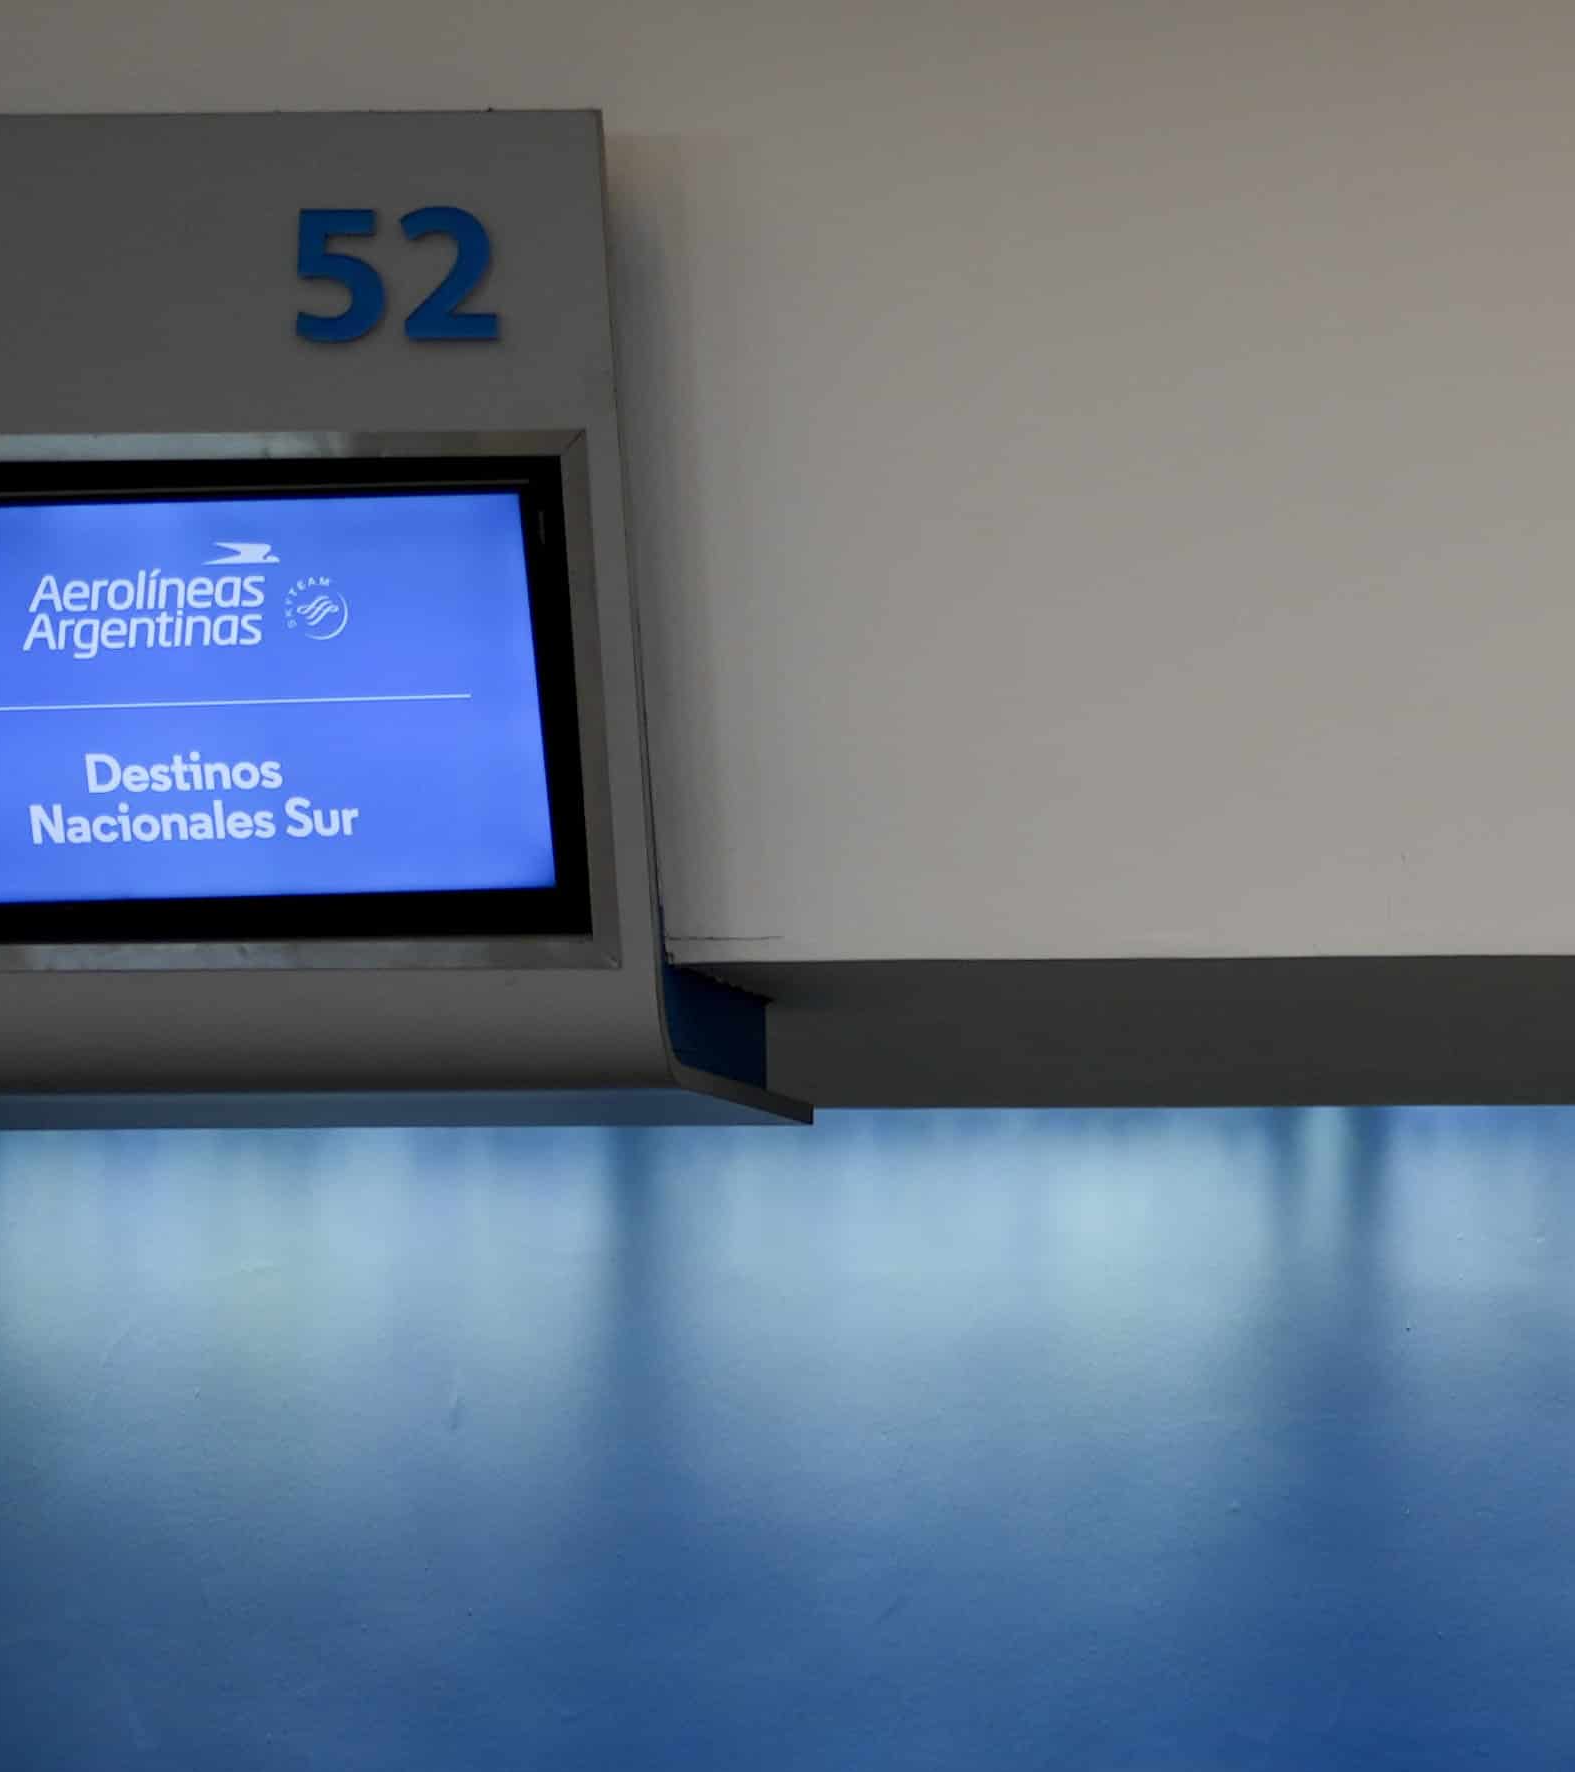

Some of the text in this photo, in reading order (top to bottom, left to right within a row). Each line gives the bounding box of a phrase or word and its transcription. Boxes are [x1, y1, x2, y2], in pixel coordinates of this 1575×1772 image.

[293, 206, 501, 345] 52
[28, 568, 265, 612] Aerolíneas
[23, 610, 263, 659] Argentinas
[85, 750, 283, 793] Destinos
[29, 797, 359, 845] Nacionales Sur
